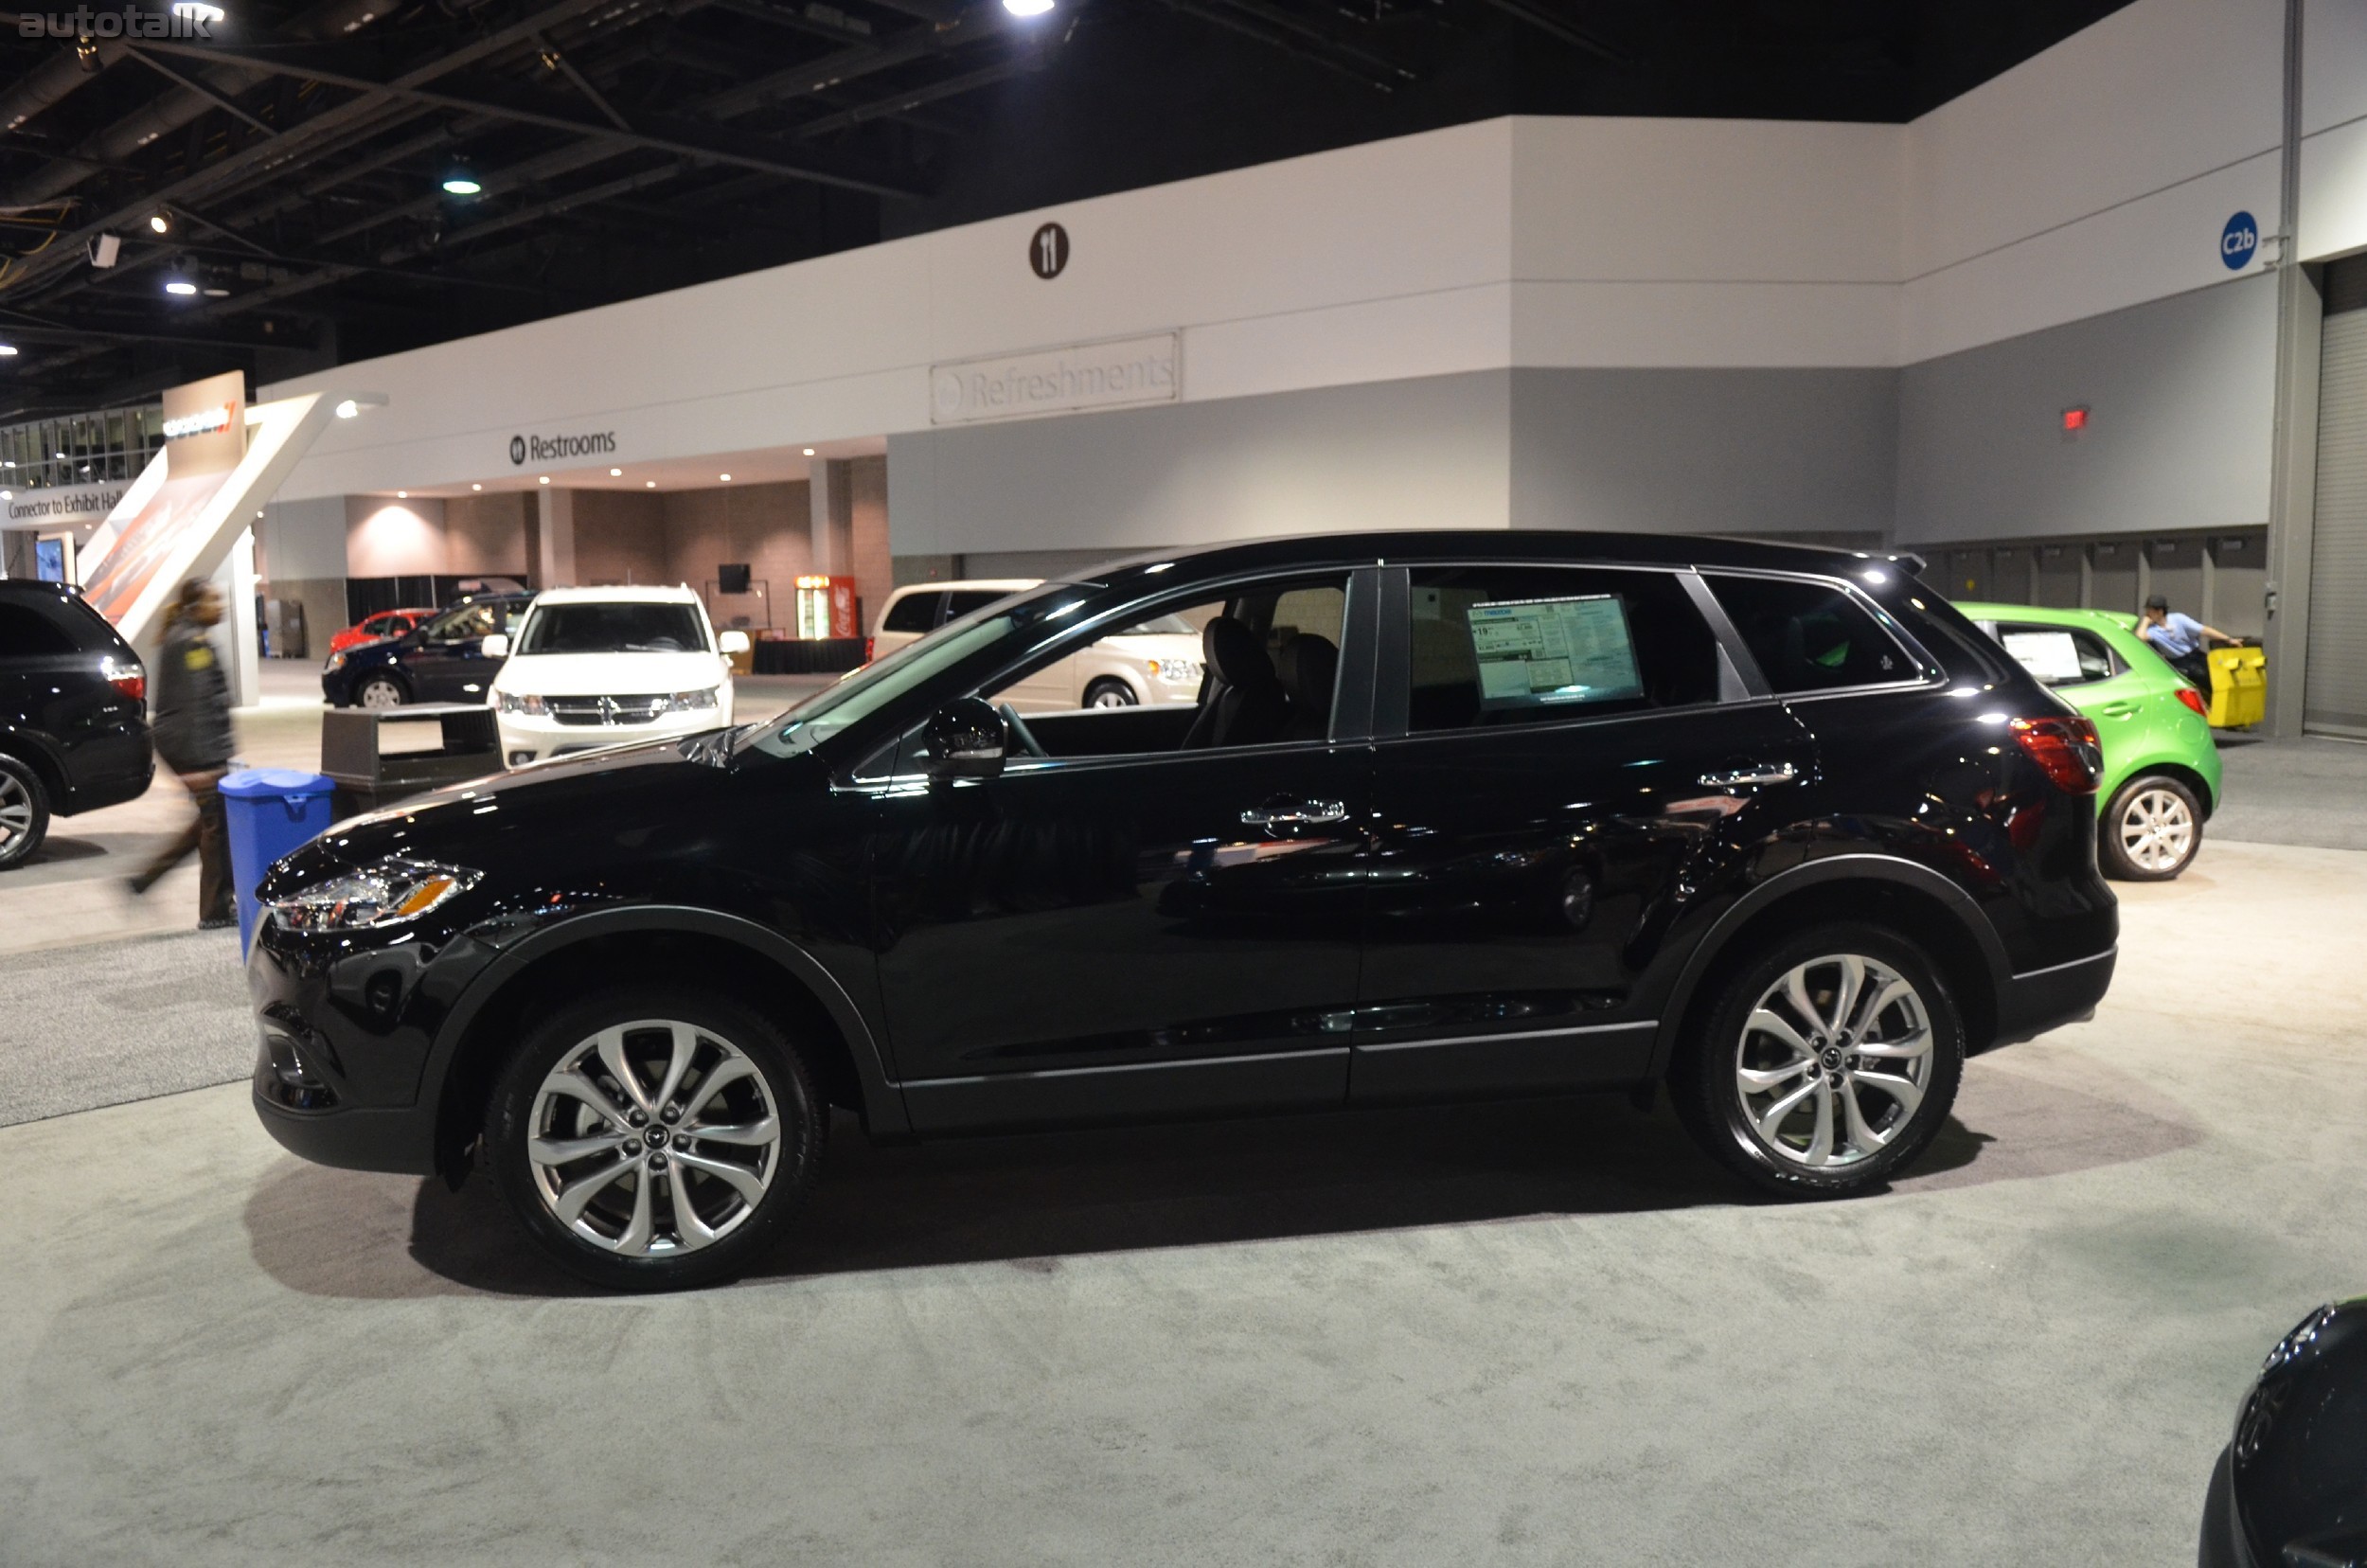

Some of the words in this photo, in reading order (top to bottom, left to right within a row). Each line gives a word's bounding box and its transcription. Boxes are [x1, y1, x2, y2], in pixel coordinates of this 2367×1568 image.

[2222, 227, 2255, 255] C2b
[971, 354, 1175, 408] Refreshments
[530, 431, 616, 461] Restrooms
[8, 500, 52, 520] Connector
[52, 496, 63, 515] to
[63, 491, 99, 514] Exhibit
